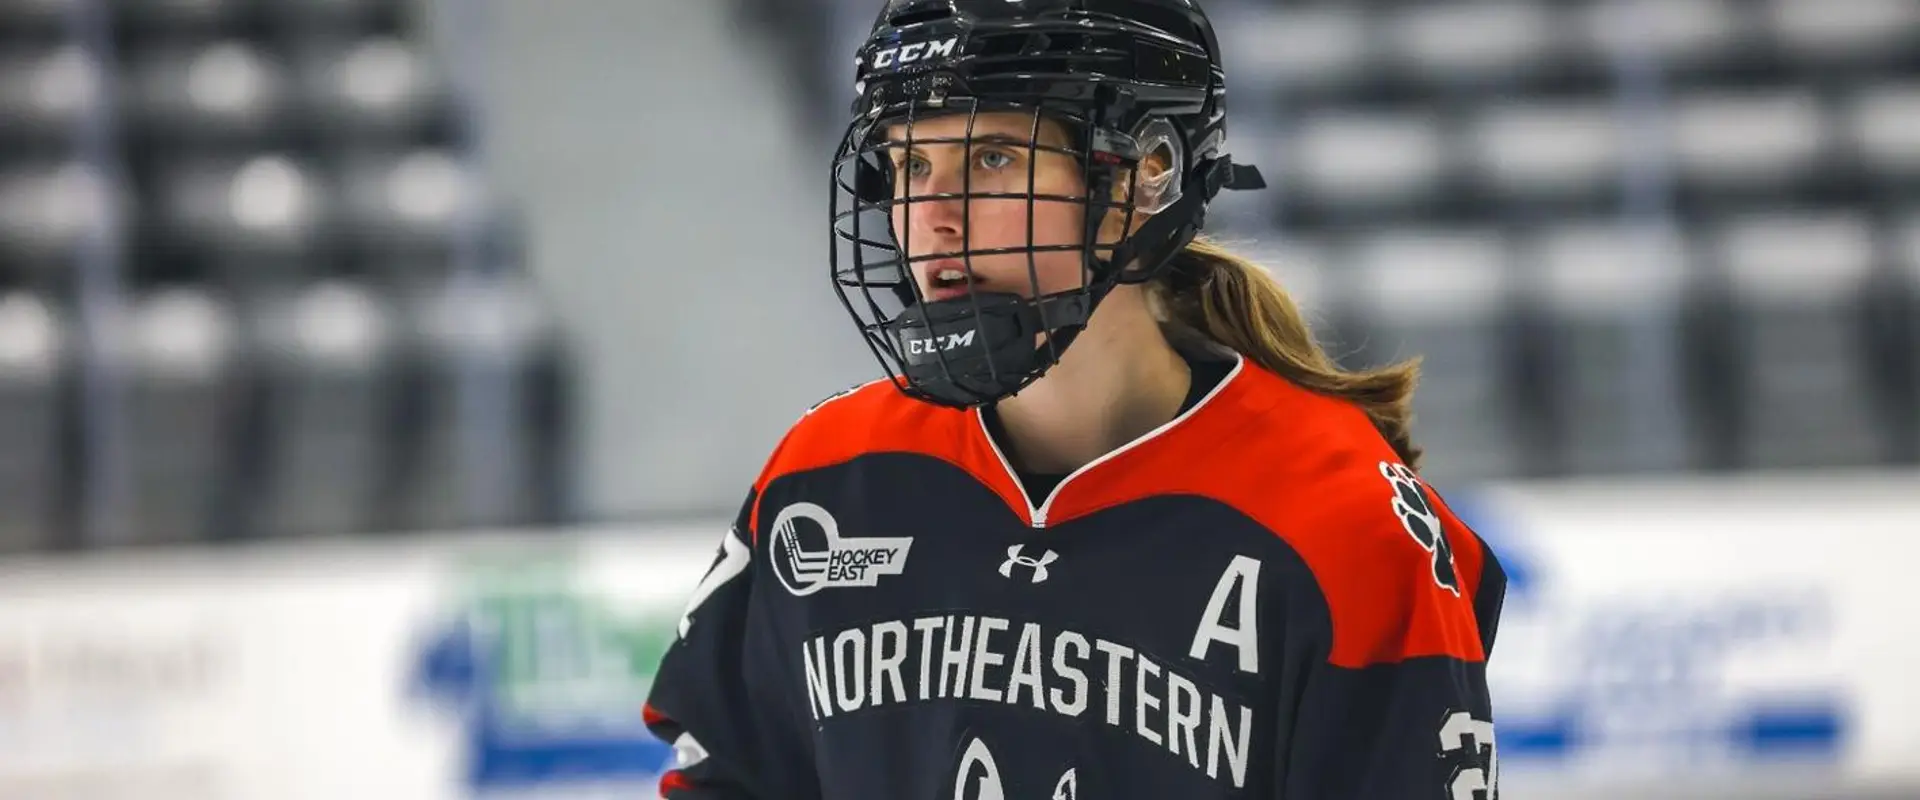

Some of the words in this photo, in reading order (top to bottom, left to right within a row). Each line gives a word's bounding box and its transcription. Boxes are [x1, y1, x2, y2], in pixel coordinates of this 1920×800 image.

[873, 37, 958, 69] CCM
[829, 548, 898, 565] HOCKEY
[827, 565, 869, 582] EAST
[1189, 554, 1261, 673] A
[802, 615, 1253, 788] NORTHEASTERN
